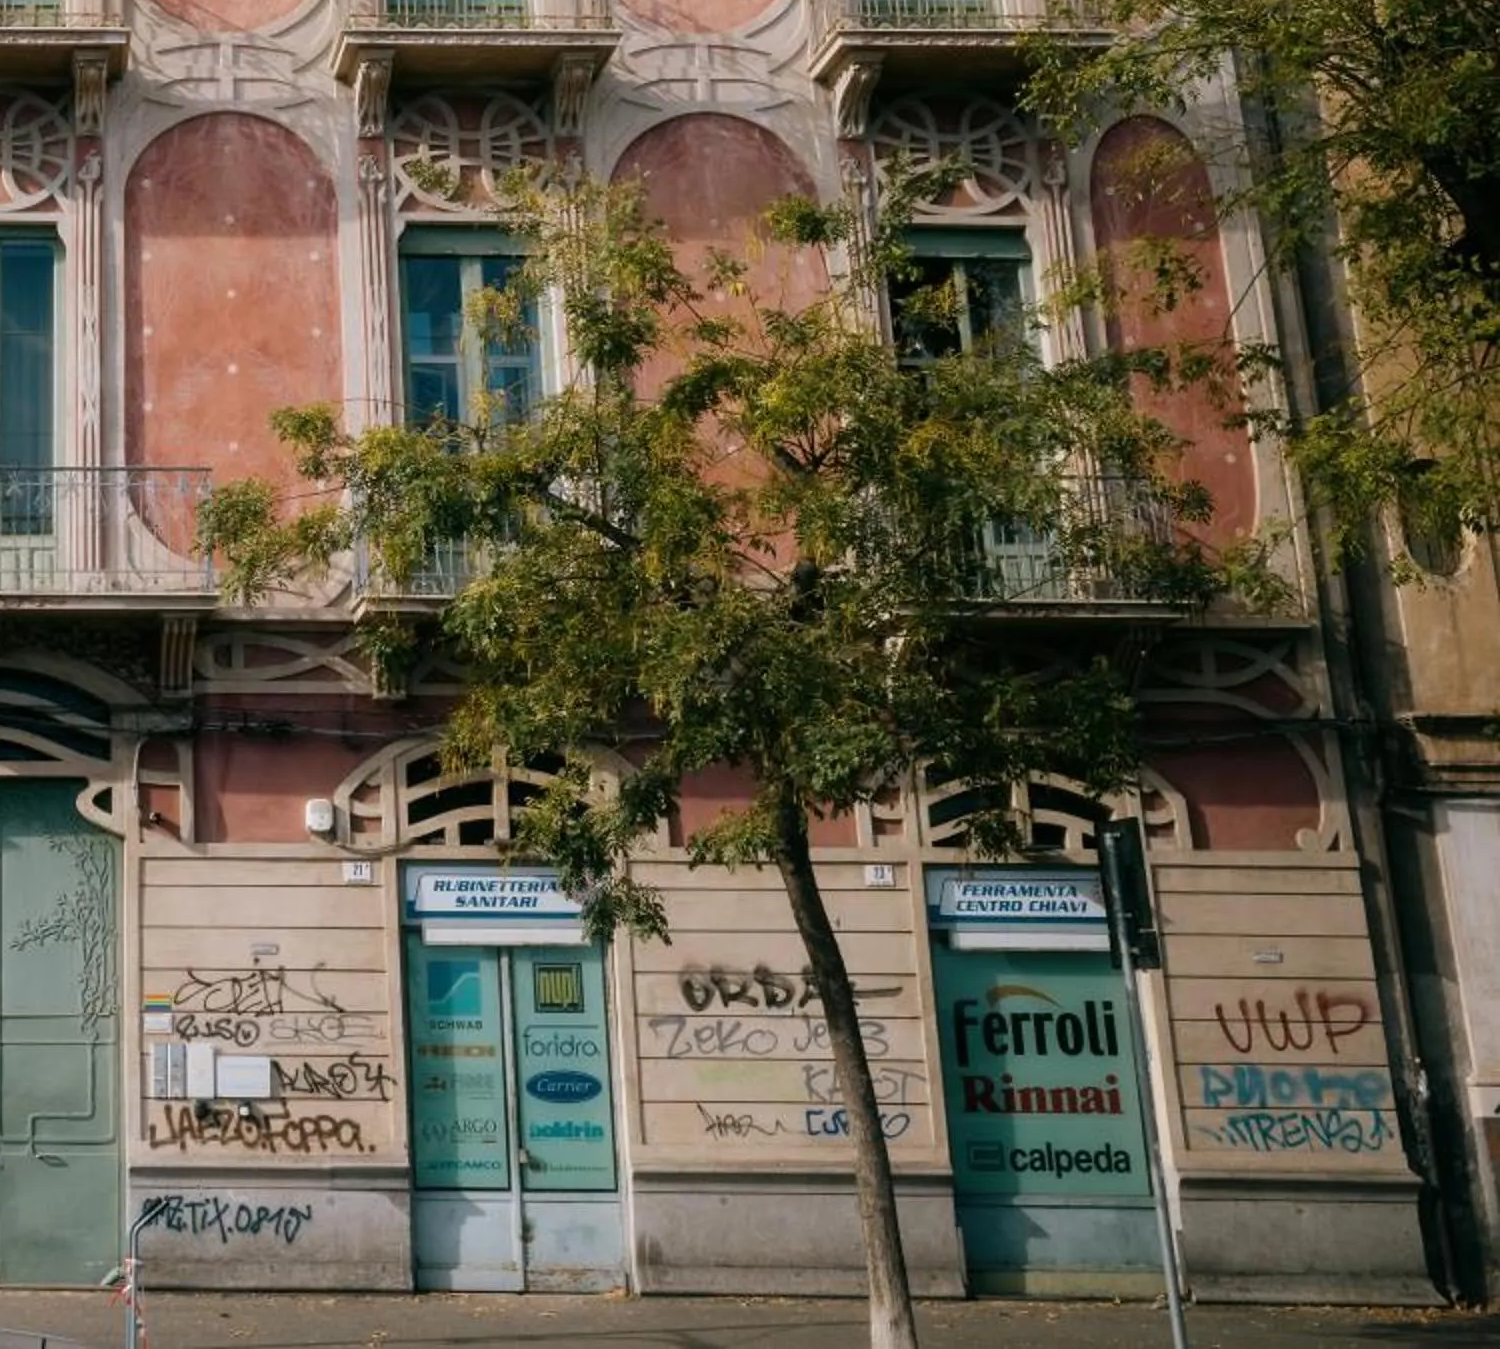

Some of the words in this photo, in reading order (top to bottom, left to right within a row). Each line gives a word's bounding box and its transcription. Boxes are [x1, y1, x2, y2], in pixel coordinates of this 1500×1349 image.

[433, 879, 558, 893] RUBINETTERIA
[961, 884, 1077, 898] FERRAMENTA
[455, 896, 539, 909] SANITARI
[956, 900, 1023, 913] CENTRO
[1028, 900, 1088, 914] CHIAVI
[429, 1020, 483, 1031] SCHWAB
[953, 999, 1119, 1068] Ferroli
[536, 1078, 593, 1093] Carrier
[961, 1073, 1125, 1115] Rinnai
[451, 1119, 497, 1134] ARGO
[1009, 1141, 1132, 1179] calpeda
